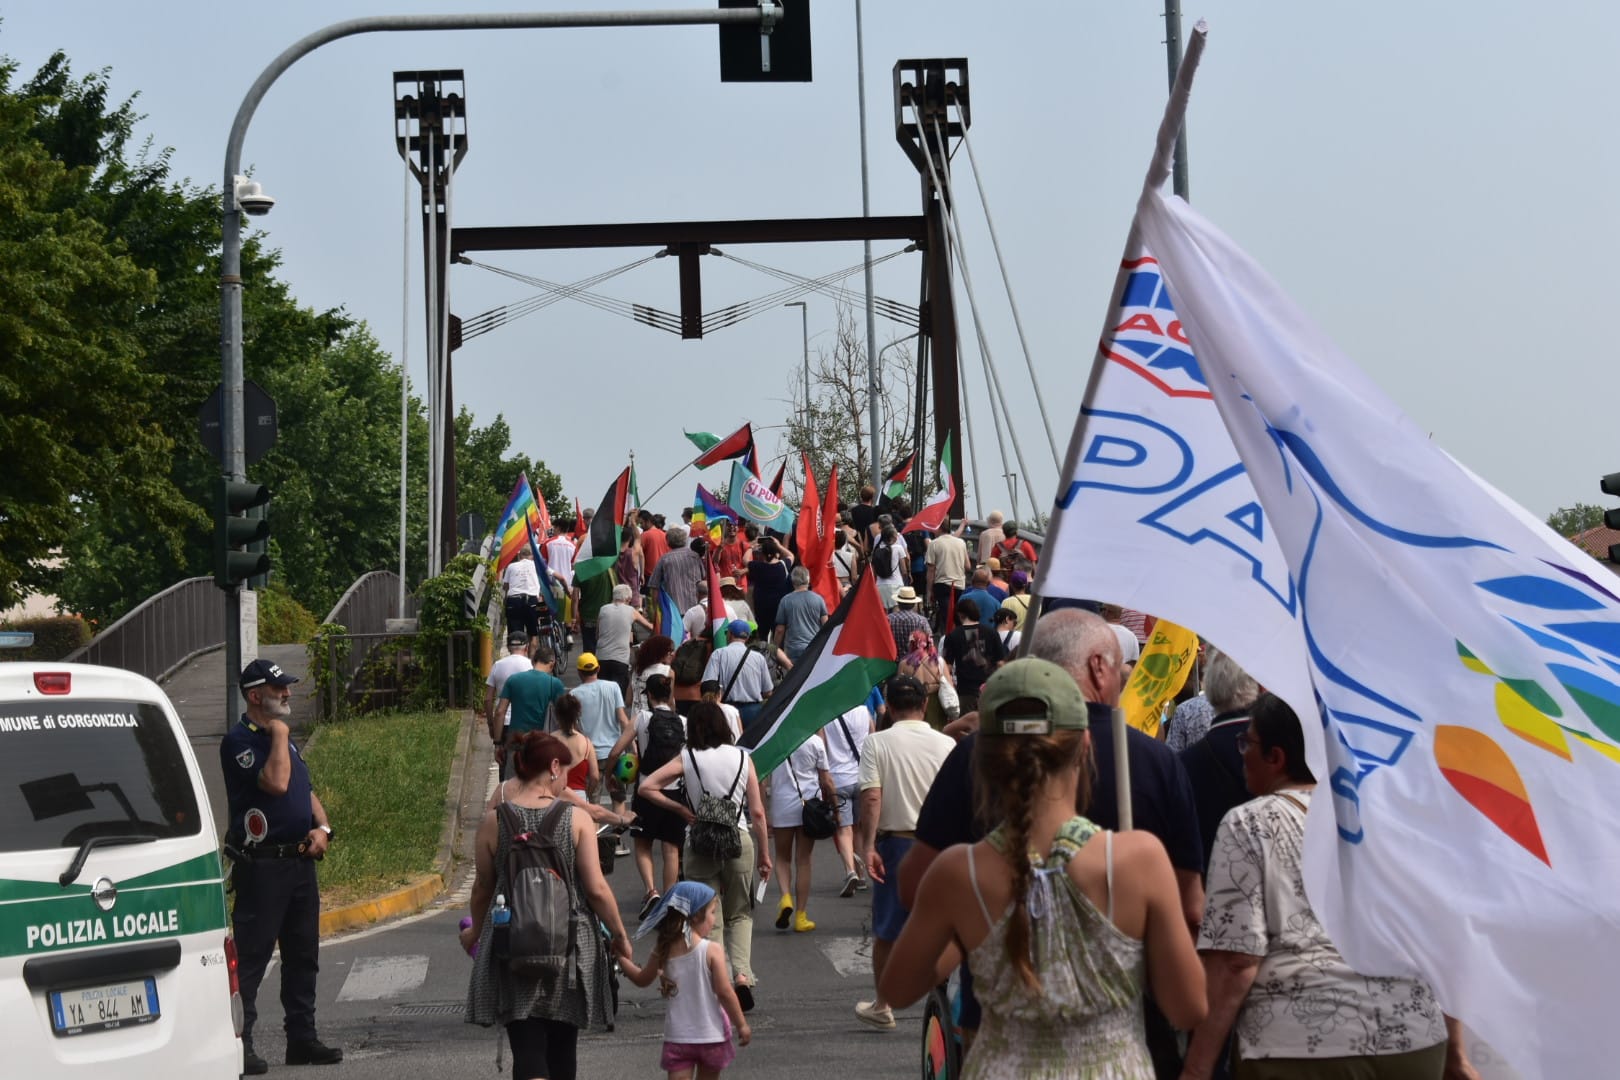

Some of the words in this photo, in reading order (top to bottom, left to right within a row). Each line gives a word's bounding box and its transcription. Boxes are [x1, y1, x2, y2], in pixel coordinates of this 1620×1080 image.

[0, 716, 41, 732] MUNE
[43, 715, 56, 729] di
[57, 713, 139, 729] GORGONZOLA
[26, 918, 106, 949] POLIZIA
[113, 909, 178, 938] LOCALE
[69, 1003, 85, 1025] YA
[98, 999, 119, 1020] 844
[130, 994, 144, 1016] AM
